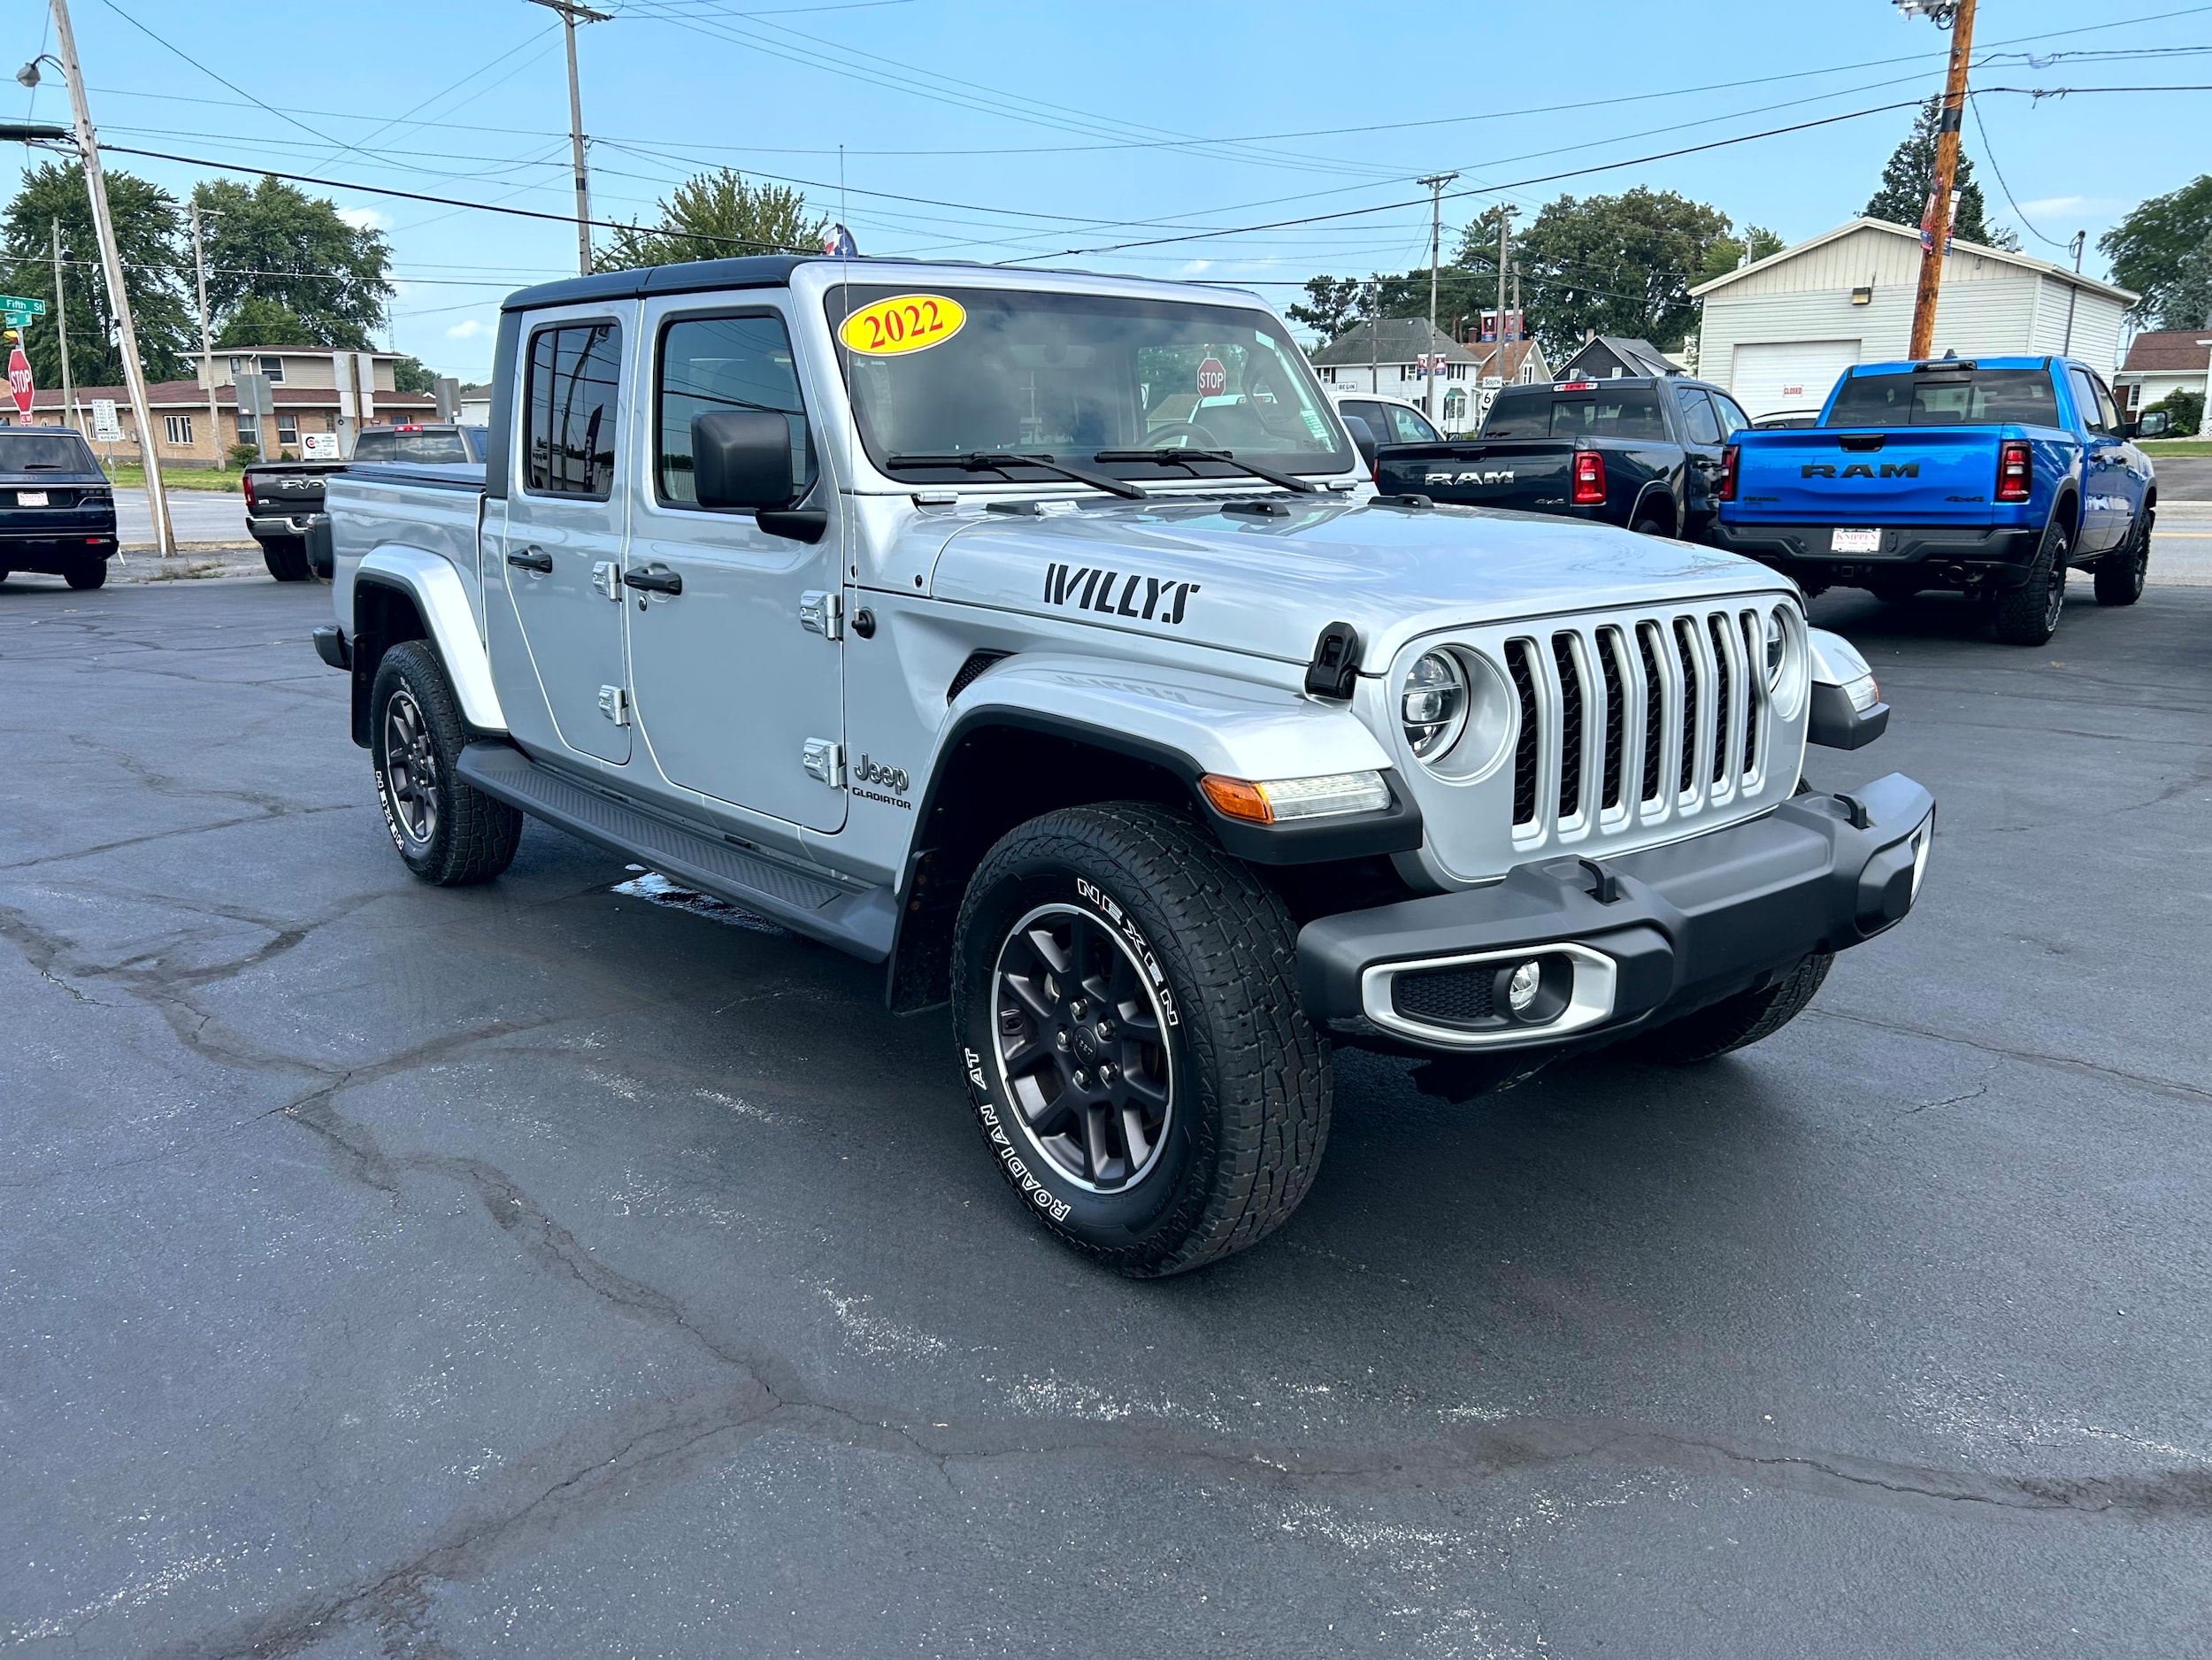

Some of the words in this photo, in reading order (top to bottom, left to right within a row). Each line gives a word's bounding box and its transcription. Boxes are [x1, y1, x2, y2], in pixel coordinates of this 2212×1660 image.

[6, 300, 27, 310] Fifth
[34, 303, 43, 311] St
[864, 300, 943, 349] 2022
[11, 369, 31, 394] STOP
[1199, 372, 1224, 388] STOP
[1425, 471, 1515, 486] RAM
[1801, 464, 1920, 479] RAM
[1836, 532, 1877, 541] KNIPPEN
[1044, 563, 1201, 624] WILLYS
[854, 752, 909, 795] Jeep
[852, 787, 911, 810] GLADIATOR
[1077, 877, 1179, 1026] NEXEN
[964, 1047, 987, 1091] AT
[979, 1103, 1071, 1222] ROADIAN
